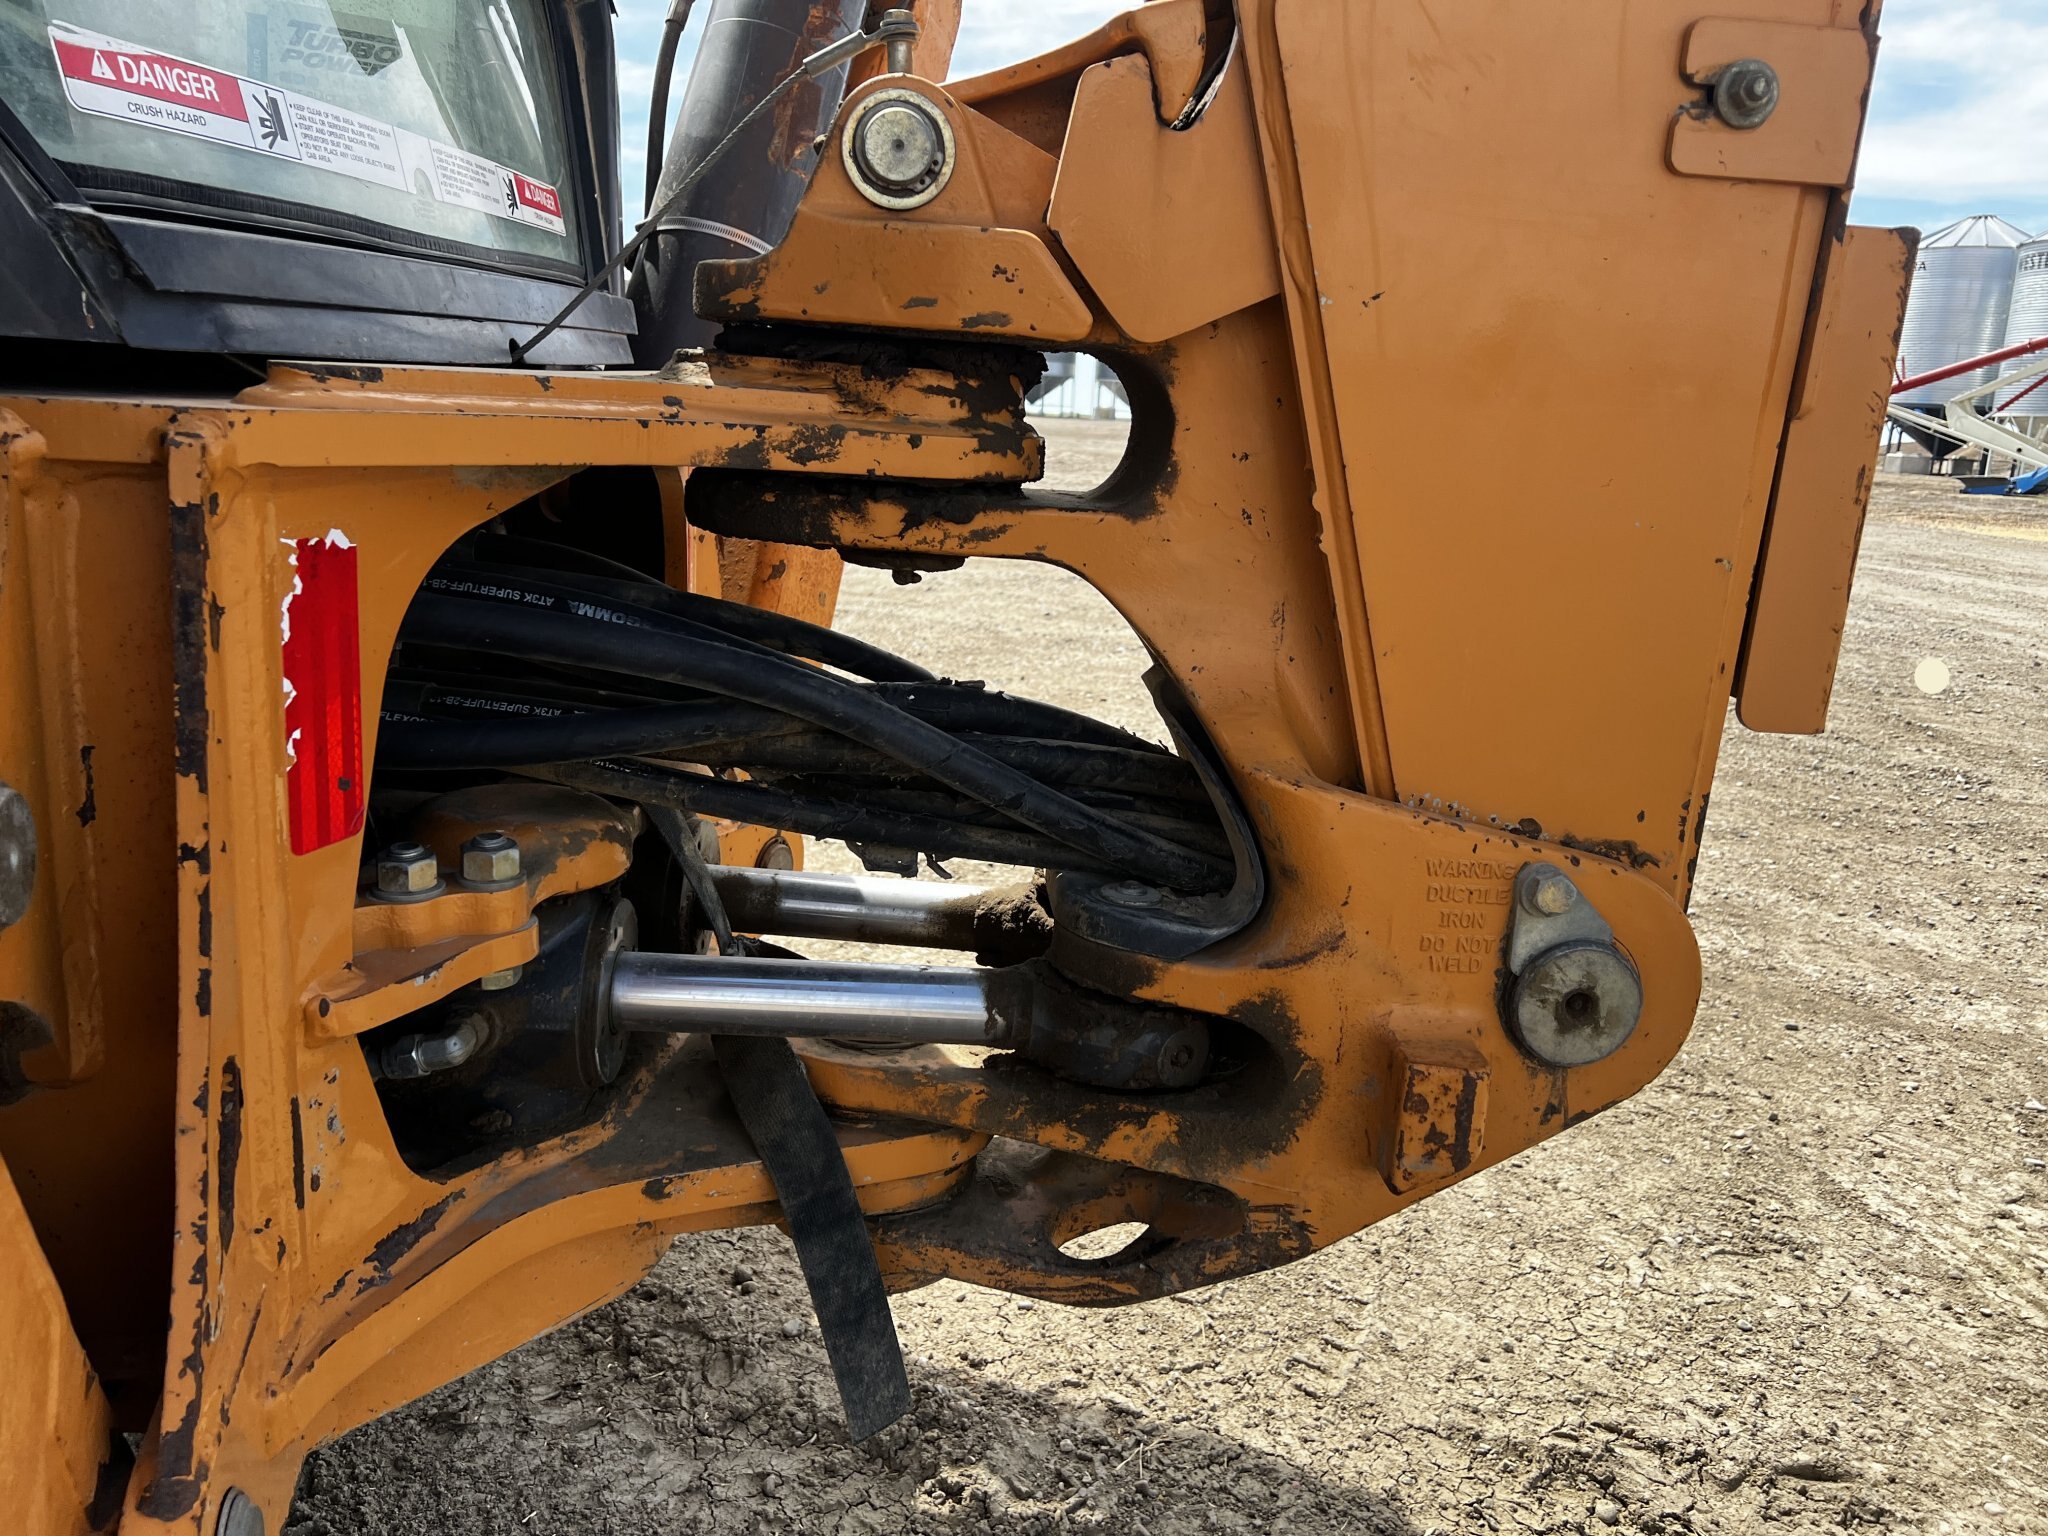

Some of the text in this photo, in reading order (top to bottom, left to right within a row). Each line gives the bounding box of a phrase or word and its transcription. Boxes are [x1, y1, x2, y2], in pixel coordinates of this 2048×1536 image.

[287, 19, 401, 64] TURBO
[117, 54, 220, 103] DANGER
[127, 101, 207, 127] CRUSH HAZARD
[523, 592, 555, 607] AT3K
[532, 705, 562, 717] AT3K
[1425, 859, 1516, 881] WARNING
[1426, 882, 1511, 906] DUCTILE
[1438, 909, 1486, 930] IRON
[1419, 935, 1497, 955] DO NOT
[1428, 954, 1483, 974] WELD
